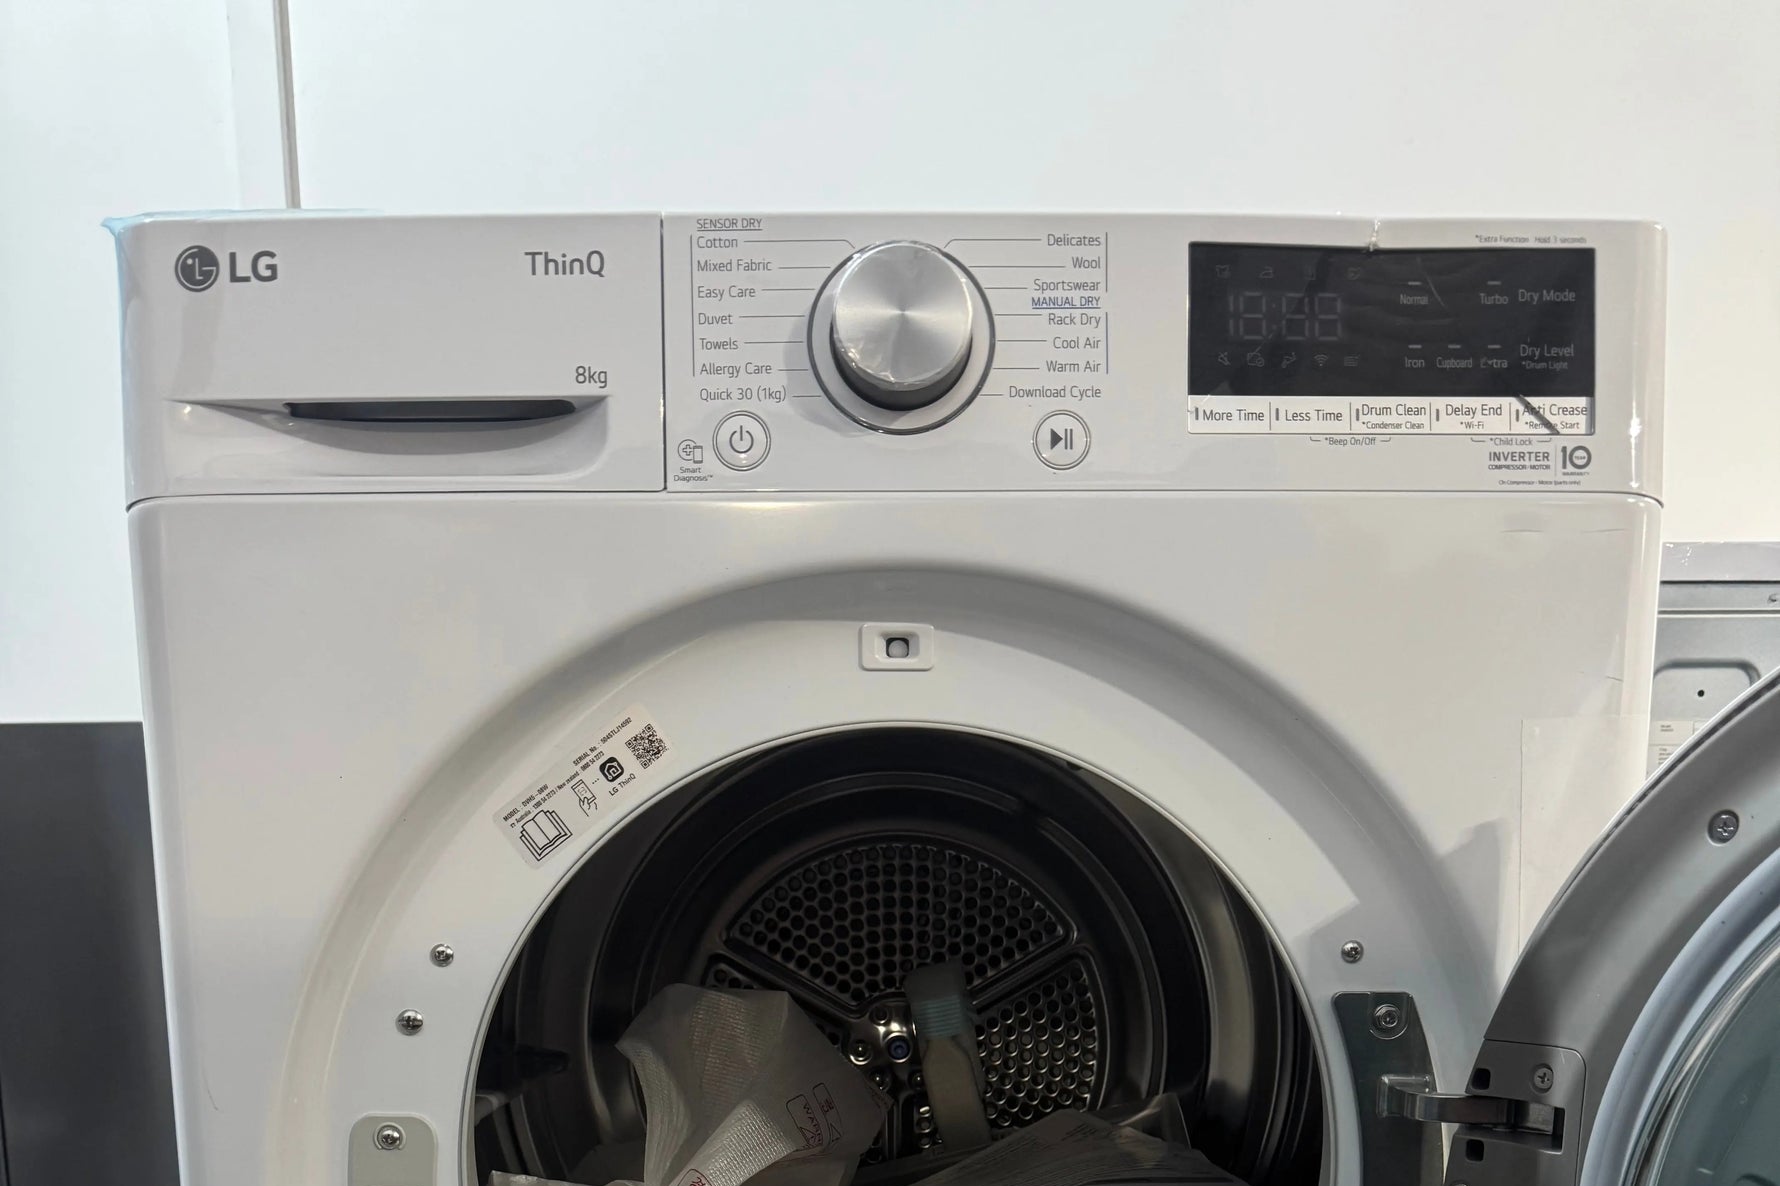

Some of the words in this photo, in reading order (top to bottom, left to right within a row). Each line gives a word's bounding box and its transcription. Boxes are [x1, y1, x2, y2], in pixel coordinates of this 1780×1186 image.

[697, 218, 736, 229] SENSOR
[738, 218, 762, 229] DRY
[696, 236, 738, 249] Cotton
[1046, 234, 1101, 247] Delicates
[228, 250, 278, 283] LG
[524, 249, 606, 279] ThinQ
[696, 259, 732, 273] Mixed
[736, 259, 773, 273] Fabric
[1071, 256, 1101, 270] Wool
[696, 285, 722, 300] Easy
[726, 285, 756, 299] Care
[1033, 278, 1101, 294] Sportswear
[1031, 296, 1075, 308] MANUAL
[1077, 296, 1100, 307] DRY
[1400, 294, 1428, 305] Normal
[1480, 293, 1509, 305] Turbo
[1518, 289, 1539, 304] Dry
[1543, 289, 1576, 302] Mode
[697, 312, 733, 326] Duvet
[1047, 312, 1076, 326] Rack
[1078, 313, 1101, 329] Dry
[699, 337, 739, 351] Towels
[1052, 336, 1080, 350] Cool
[1084, 336, 1101, 350] Air
[1520, 344, 1540, 359] Dry
[1544, 344, 1574, 357] Level
[1046, 360, 1080, 374] Warm
[1084, 360, 1101, 374] Air
[1404, 357, 1425, 368] Iron
[1436, 357, 1473, 370] Cupboard
[1549, 361, 1568, 371] Light
[574, 365, 608, 389] 8kg
[699, 362, 741, 378] Allergy
[744, 362, 773, 375] Care
[699, 387, 732, 402] Quick
[737, 387, 753, 401] 30
[756, 387, 786, 404] (1kg)
[1008, 385, 1066, 399] Download
[1070, 385, 1101, 401] Cycle
[1202, 409, 1233, 422] More
[1237, 409, 1264, 422] Time
[1285, 409, 1311, 422] Less
[1315, 409, 1343, 422] Time
[1361, 403, 1390, 418] Drum
[1395, 403, 1427, 418] Clean
[1445, 404, 1477, 418] Delay
[1481, 404, 1502, 416] End
[1550, 404, 1588, 416] Crease
[1407, 421, 1425, 431] Clean
[1560, 421, 1580, 430] Start
[1350, 437, 1376, 446] On/Off
[1515, 437, 1533, 446] Lock
[1489, 451, 1550, 462] INVERTER
[1561, 445, 1592, 470] 10
[680, 466, 701, 474] Smart
[573, 752, 590, 766] SERIAL
[609, 786, 619, 796] LG
[618, 773, 636, 789] ThinQ
[503, 808, 520, 821] MODEL
